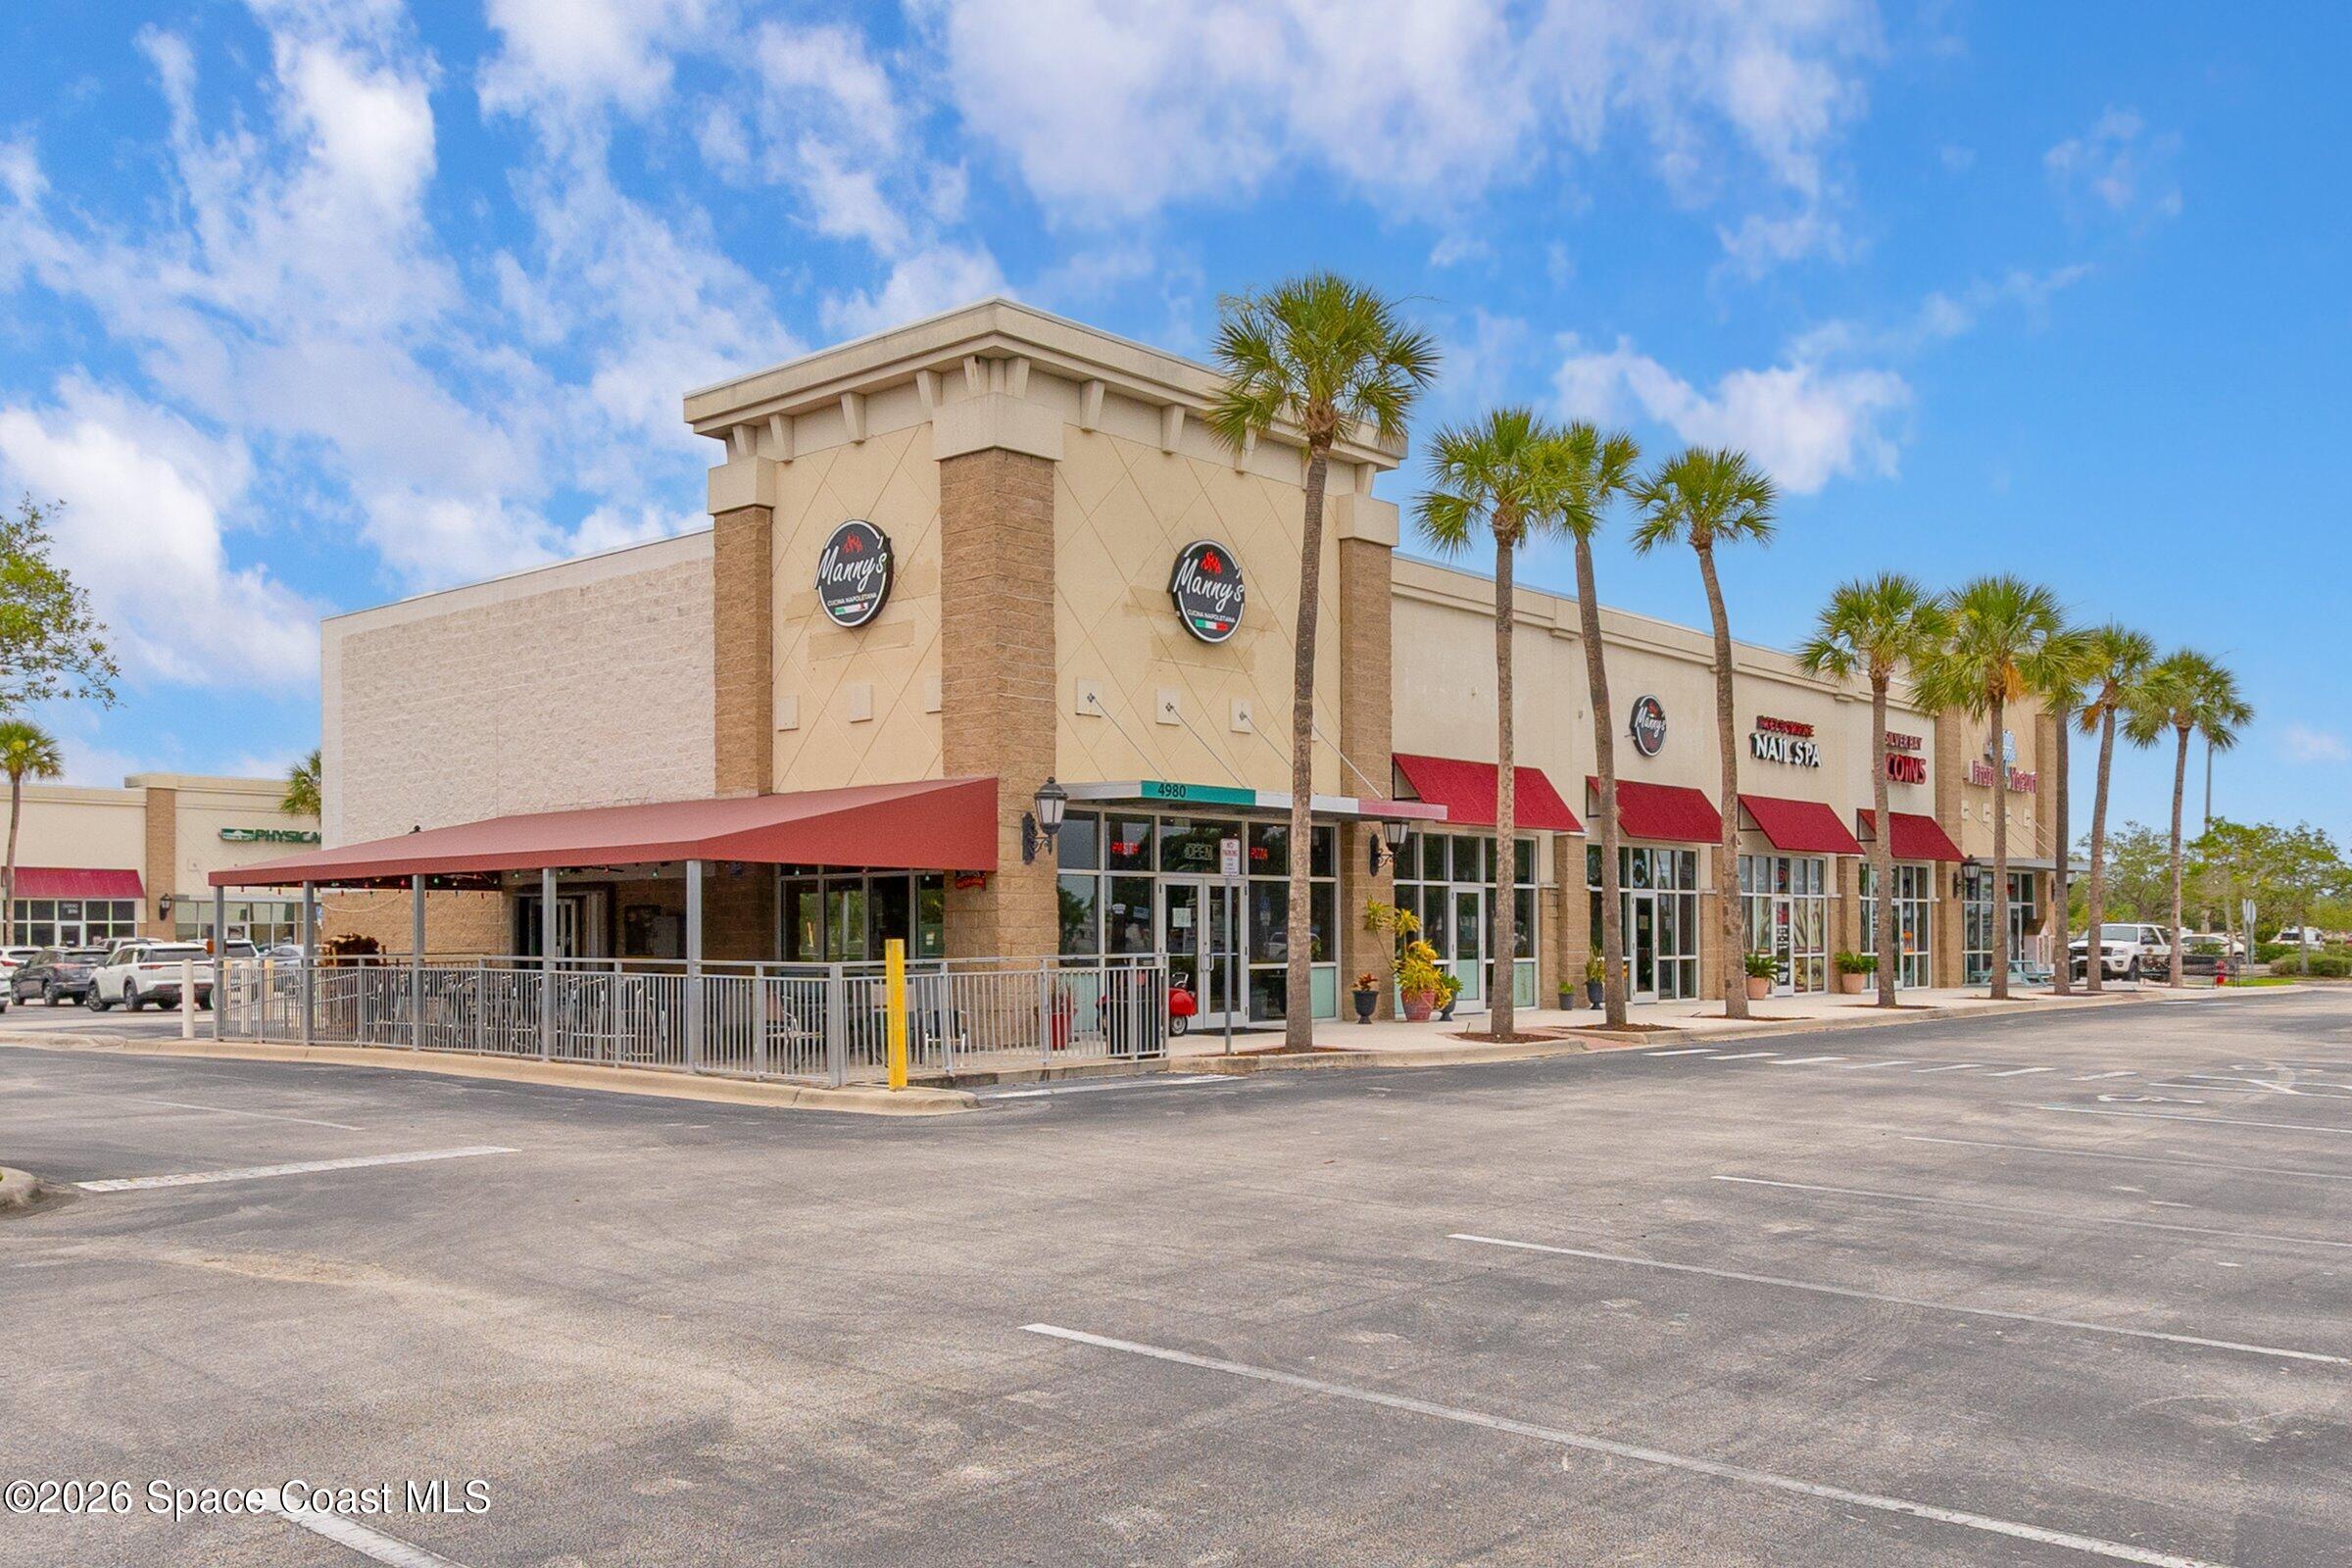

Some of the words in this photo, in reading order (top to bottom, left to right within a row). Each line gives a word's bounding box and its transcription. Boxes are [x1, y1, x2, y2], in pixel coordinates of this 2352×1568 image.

[814, 536, 888, 593] Manny's
[1173, 558, 1245, 612] Manny's
[1753, 733, 1792, 763] NAIL
[1793, 741, 1822, 767] SPA
[1885, 753, 1927, 785] COINS
[1157, 784, 1186, 798] 4980
[254, 829, 321, 844] PHYSICA
[1186, 845, 1212, 859] OPEN
